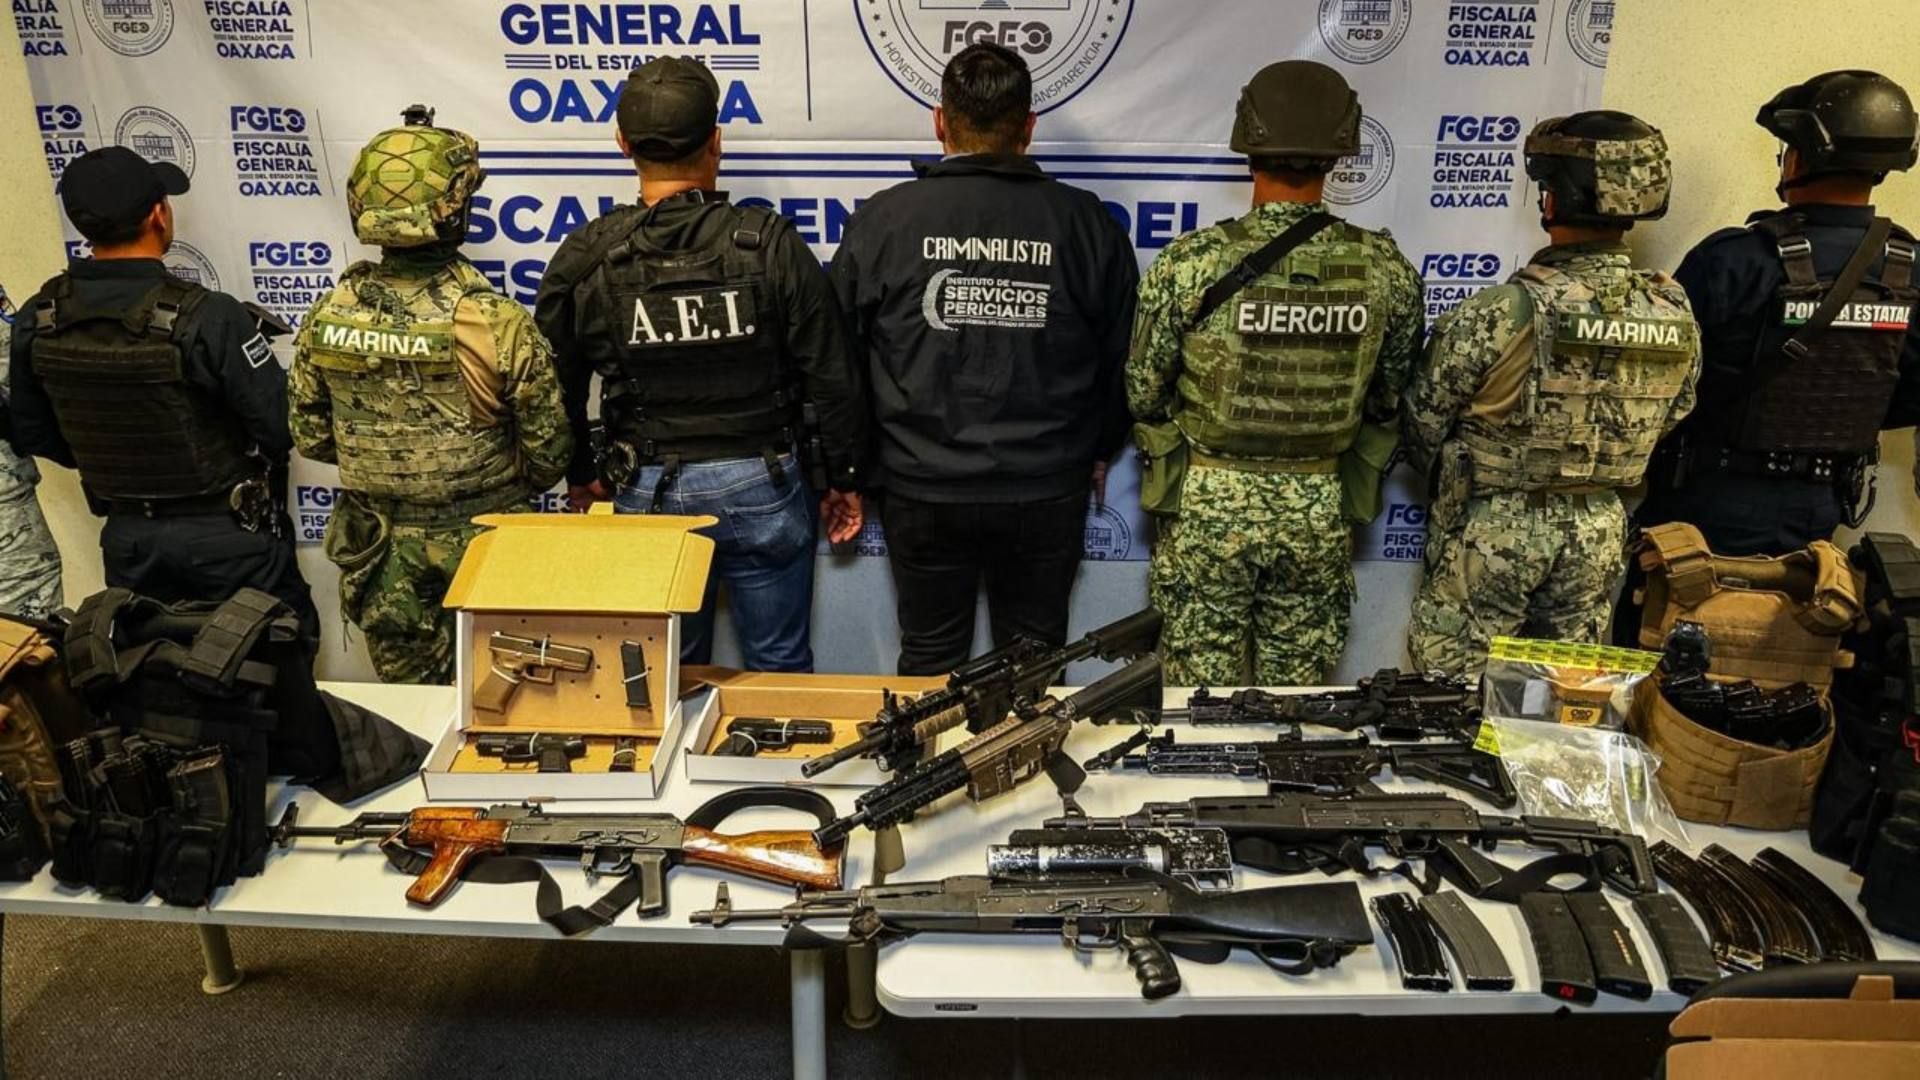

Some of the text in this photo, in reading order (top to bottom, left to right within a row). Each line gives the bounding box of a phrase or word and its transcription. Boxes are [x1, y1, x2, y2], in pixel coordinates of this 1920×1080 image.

[204, 0, 292, 15] FISCALÍA
[1449, 6, 1536, 22] FISCALÍA
[210, 18, 294, 32] GENERAL
[500, 4, 761, 45] GENERAL
[1448, 24, 1535, 39] GENERAL
[216, 42, 295, 59] OAXACA
[1445, 49, 1529, 66] OAXACA
[555, 54, 592, 70] DEL
[230, 106, 306, 133] FGEO
[1437, 116, 1521, 142] FGEO
[233, 142, 313, 157] FISCALÍA
[236, 158, 317, 172] GENERAL
[1434, 152, 1515, 167] FISCALÍA
[1433, 169, 1514, 183] GENERAL
[239, 181, 322, 196] OAXACA
[1430, 193, 1509, 208] OAXACA
[250, 242, 332, 266] FGEO
[923, 236, 1052, 266] CRIMINALISTA
[1421, 253, 1501, 278] FGEO
[254, 276, 334, 290] FISCALÍA
[946, 277, 994, 286] INSTITUTO
[944, 286, 1049, 305] SERVICIOS
[628, 291, 756, 345] A.E.I.
[943, 301, 1047, 318] PERICIALES
[1854, 304, 1910, 323] ESTATAL
[1238, 304, 1368, 333] EJERCITO
[323, 325, 430, 356] MARINA
[1577, 318, 1680, 346] MARINA
